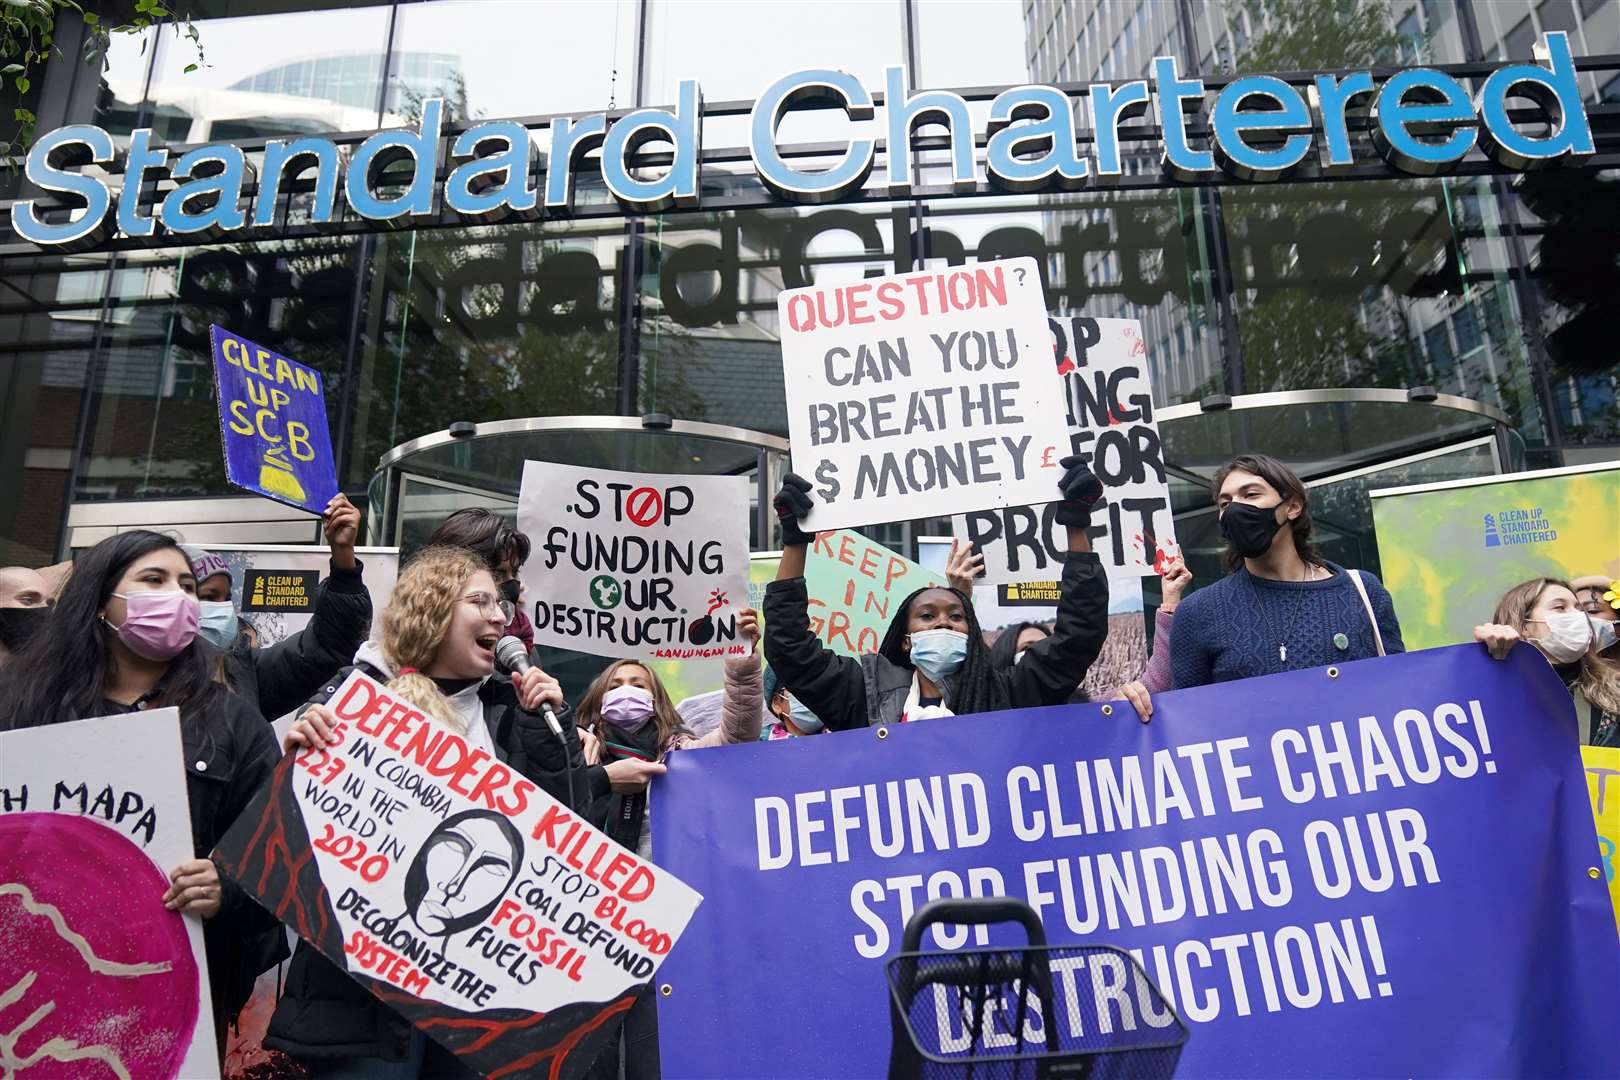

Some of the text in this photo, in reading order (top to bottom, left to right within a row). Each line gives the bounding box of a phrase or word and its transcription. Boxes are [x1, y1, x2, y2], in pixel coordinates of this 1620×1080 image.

[11, 30, 1597, 245] Standard Chartered
[787, 265, 1008, 333] QUESTION
[222, 338, 319, 395] CLEAN
[824, 328, 1019, 386] CAN YOU
[246, 376, 290, 411] UP
[808, 381, 1025, 447] BREATHE
[1064, 366, 1152, 427] ING
[228, 399, 315, 462] SCB
[814, 459, 841, 503] $
[853, 435, 1032, 500] MONEY
[1498, 508, 1543, 523] CLEAN UP
[1500, 519, 1550, 534] STANDARD
[1503, 530, 1557, 545] CHARTERED
[266, 586, 305, 596] STANDARD
[268, 576, 303, 587] CLEAN UP
[813, 531, 908, 592] KEEP
[265, 596, 309, 607] CHARTERED
[844, 578, 889, 620] IN
[295, 746, 409, 826] 227 IN THE
[335, 677, 656, 903] DEFENDERS KILLED
[347, 737, 377, 767] IN
[376, 757, 452, 820] COLOMBIA
[753, 699, 1497, 871] DEFUND CLIMATE CHAOS!
[52, 780, 157, 847] MAPA
[305, 778, 406, 864] WORLD IN
[313, 823, 389, 884] 2020
[850, 807, 1441, 959] STOP FUNDING OUR
[515, 879, 655, 979] COAL DEFUND
[531, 855, 673, 955] STOP BLOOD
[336, 887, 497, 1007] DECOLONIZE THE
[343, 930, 430, 997] SYSTEM
[465, 926, 542, 985] FUELS
[491, 899, 586, 982] FOSSIL
[930, 915, 1394, 1055] DESTRUCTION!
